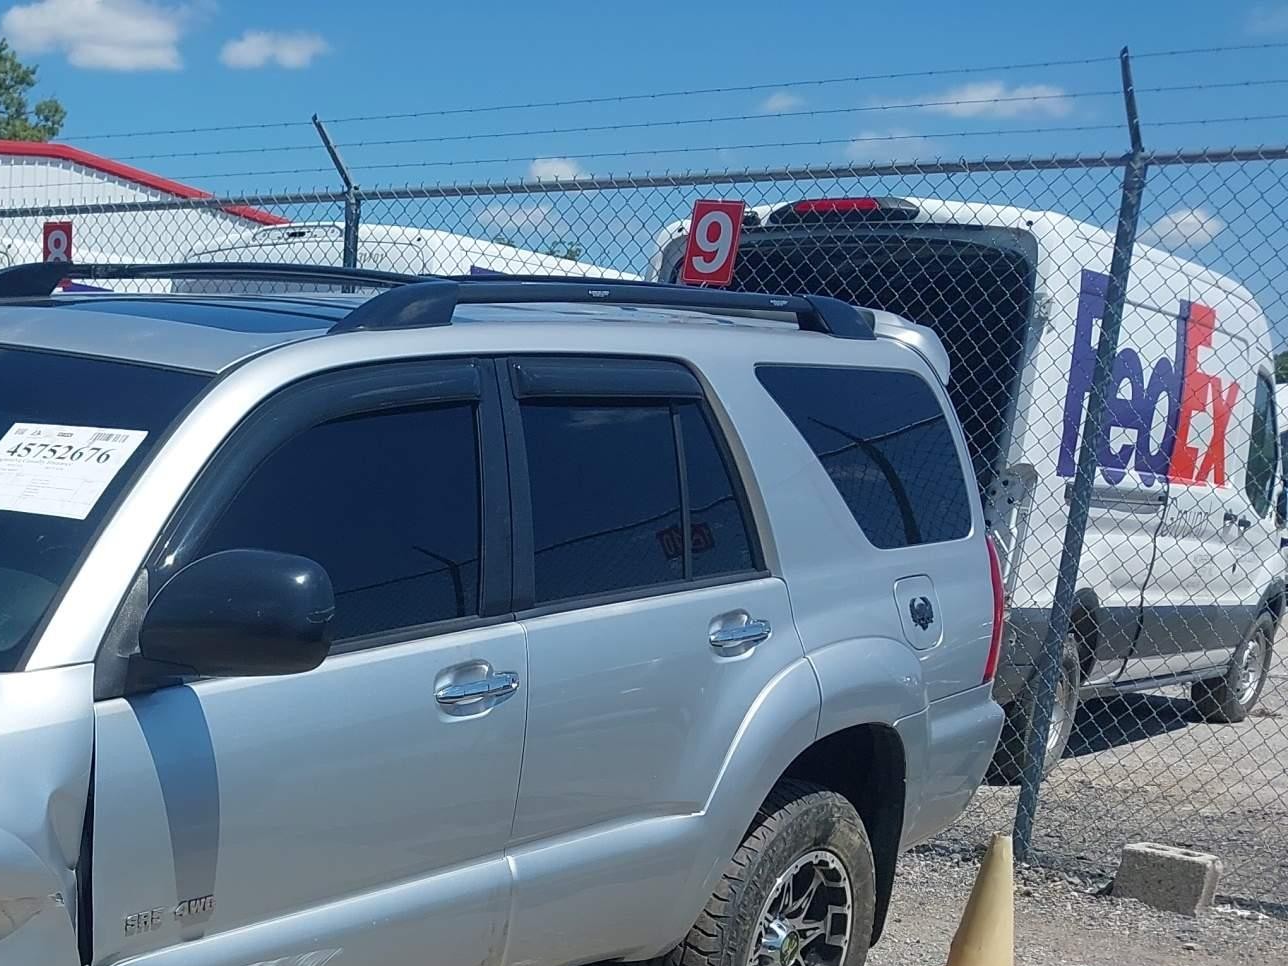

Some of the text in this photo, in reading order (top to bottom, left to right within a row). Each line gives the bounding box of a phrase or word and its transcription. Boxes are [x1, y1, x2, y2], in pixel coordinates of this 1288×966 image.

[47, 229, 69, 262] 8
[692, 211, 733, 274] 9
[1057, 268, 1242, 489] FedEx
[6, 441, 118, 464] 45752676
[175, 894, 216, 919] 4WD
